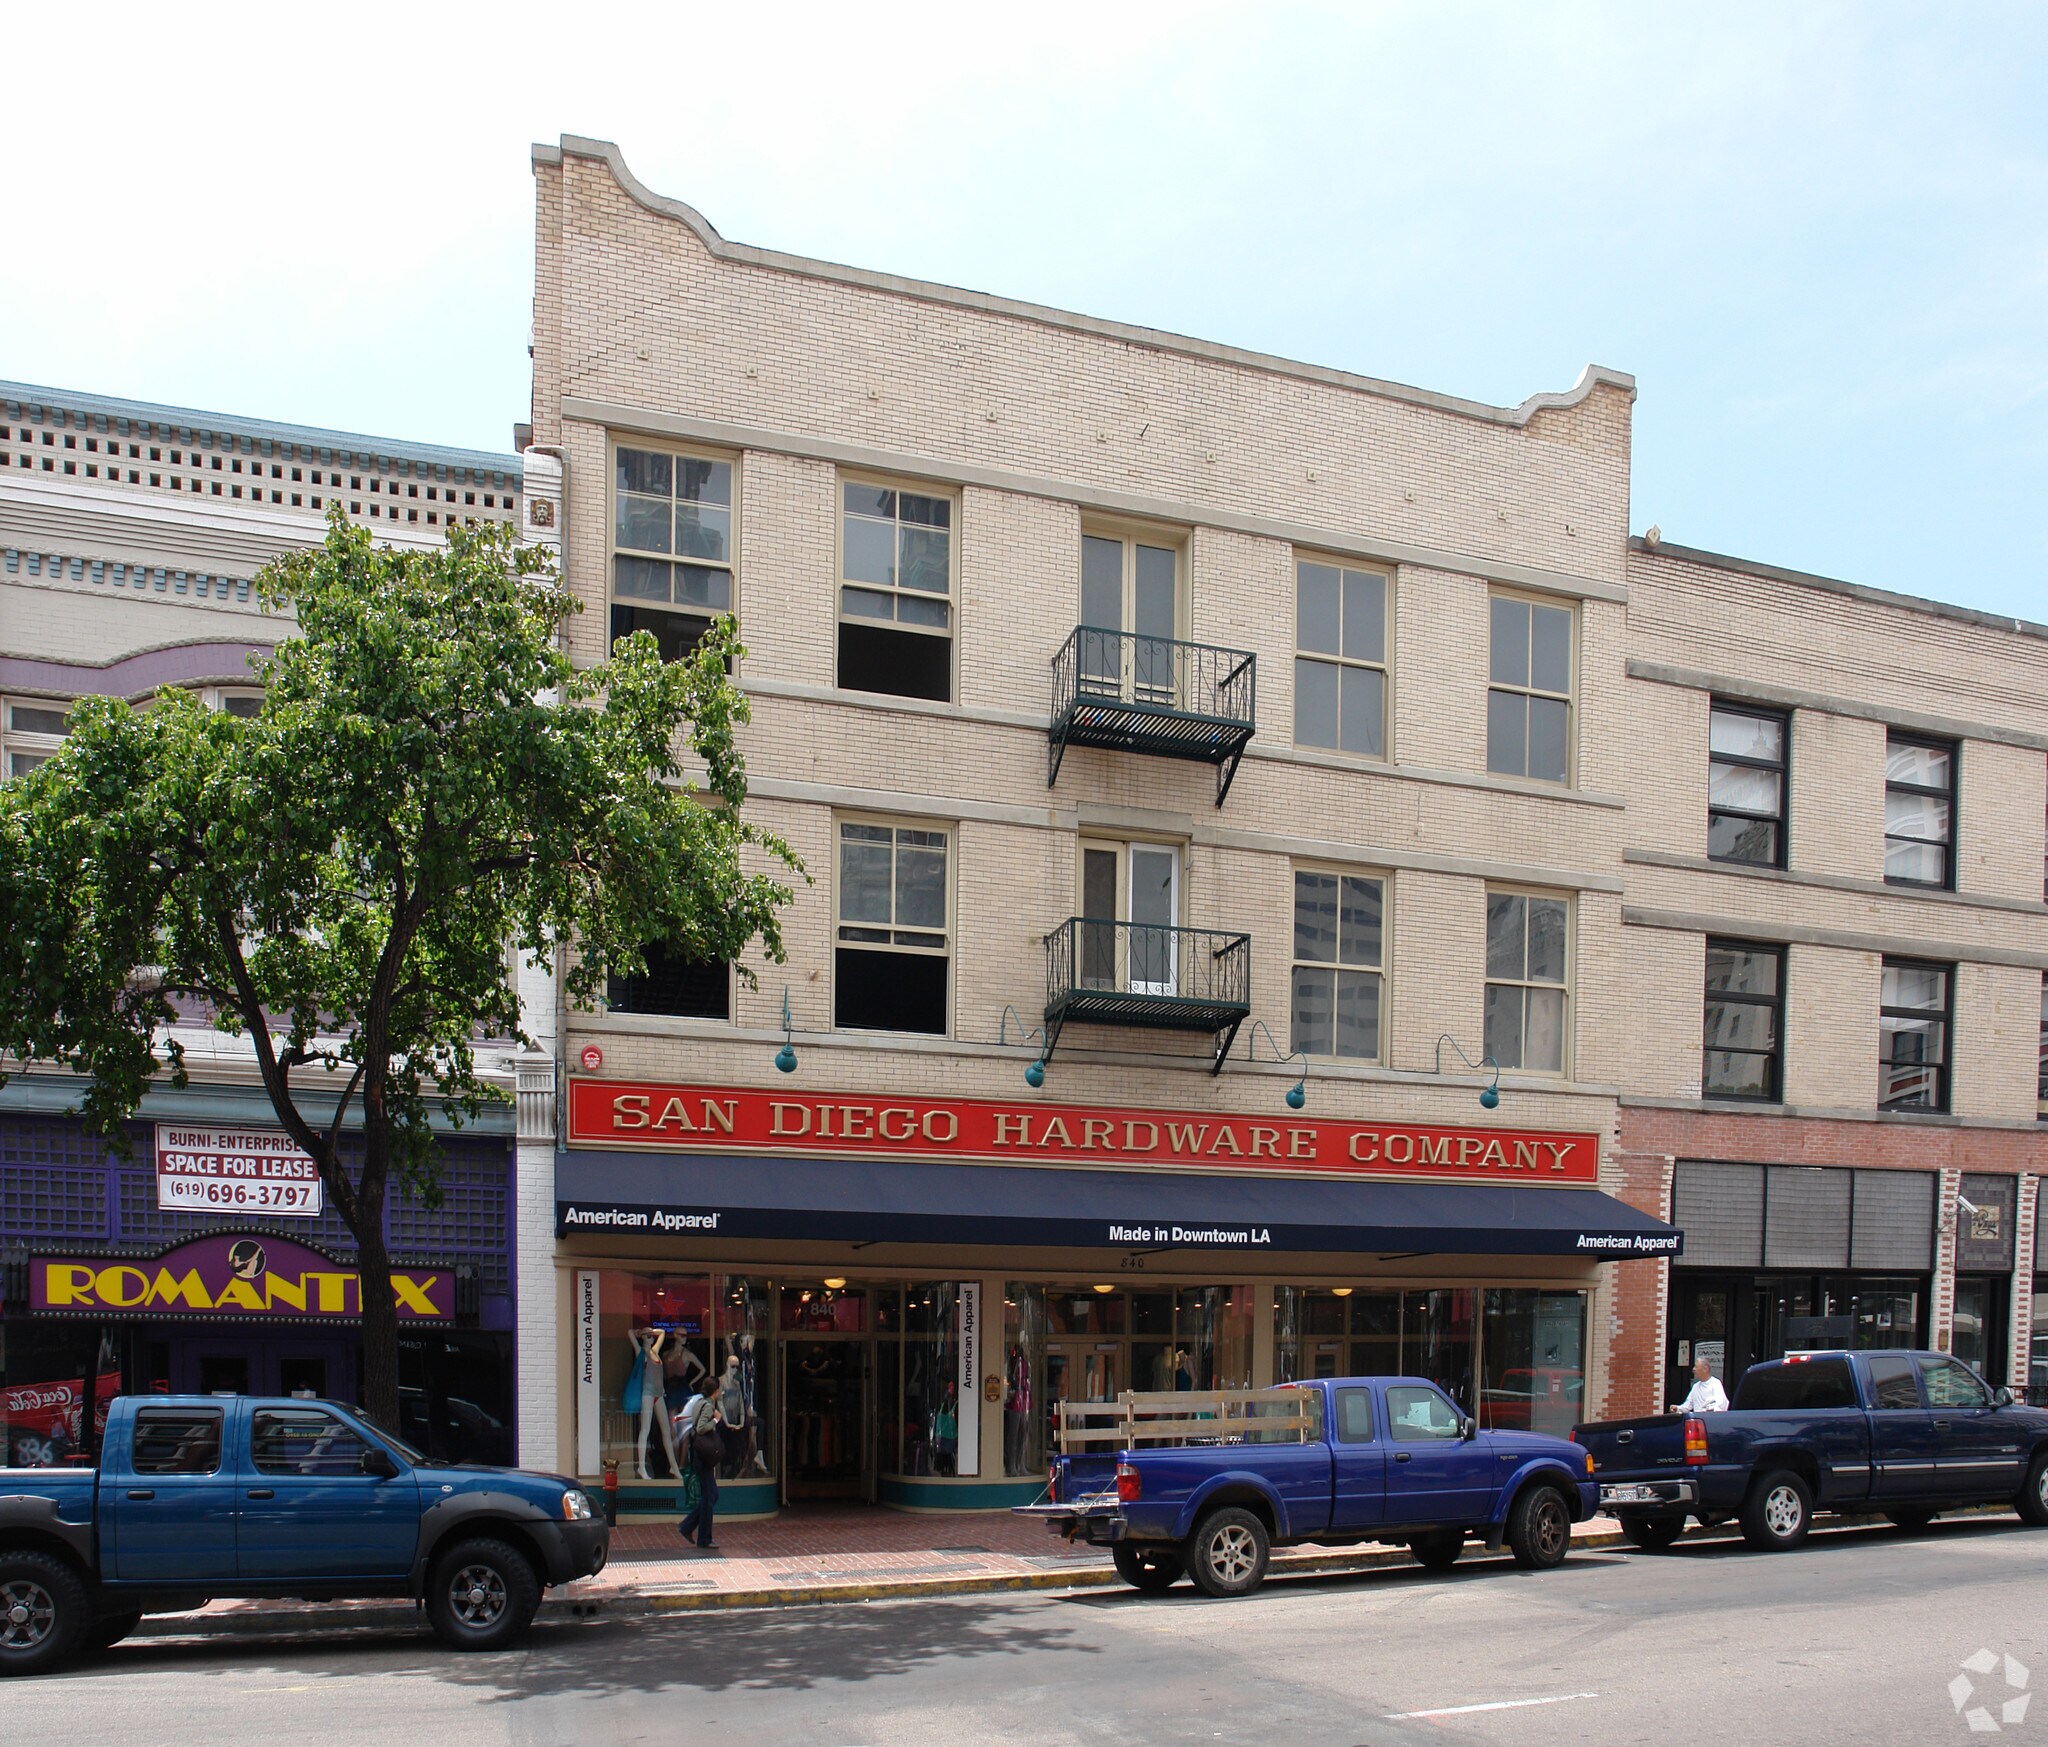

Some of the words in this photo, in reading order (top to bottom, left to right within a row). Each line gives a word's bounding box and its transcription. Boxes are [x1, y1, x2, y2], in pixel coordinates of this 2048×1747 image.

[169, 1132, 302, 1152] BURNI-ENTERPRISE
[613, 1094, 739, 1134] SAN
[769, 1101, 958, 1142] DIEGO
[992, 1113, 1317, 1159] HARDWARE
[1349, 1132, 1577, 1170] COMPANY
[165, 1153, 217, 1174] SPACE
[223, 1156, 257, 1176] FOR
[262, 1158, 314, 1178] LEASE
[171, 1180, 205, 1198] (619)
[207, 1183, 311, 1206] 696-3797
[564, 1207, 648, 1226] American
[651, 1210, 718, 1231] Apparel
[1109, 1225, 1151, 1241] Made
[1154, 1226, 1169, 1241] in
[1171, 1227, 1248, 1243] Downtown
[1251, 1228, 1271, 1243] LA
[1576, 1234, 1632, 1249] American
[1633, 1235, 1678, 1251] Apparel
[1120, 1257, 1145, 1269] 840
[46, 1263, 441, 1315] ROMANTX
[583, 1278, 594, 1324] Apparel
[810, 1302, 837, 1316] 840
[964, 1290, 974, 1333] Apparel
[583, 1327, 593, 1384] American
[963, 1336, 973, 1389] American
